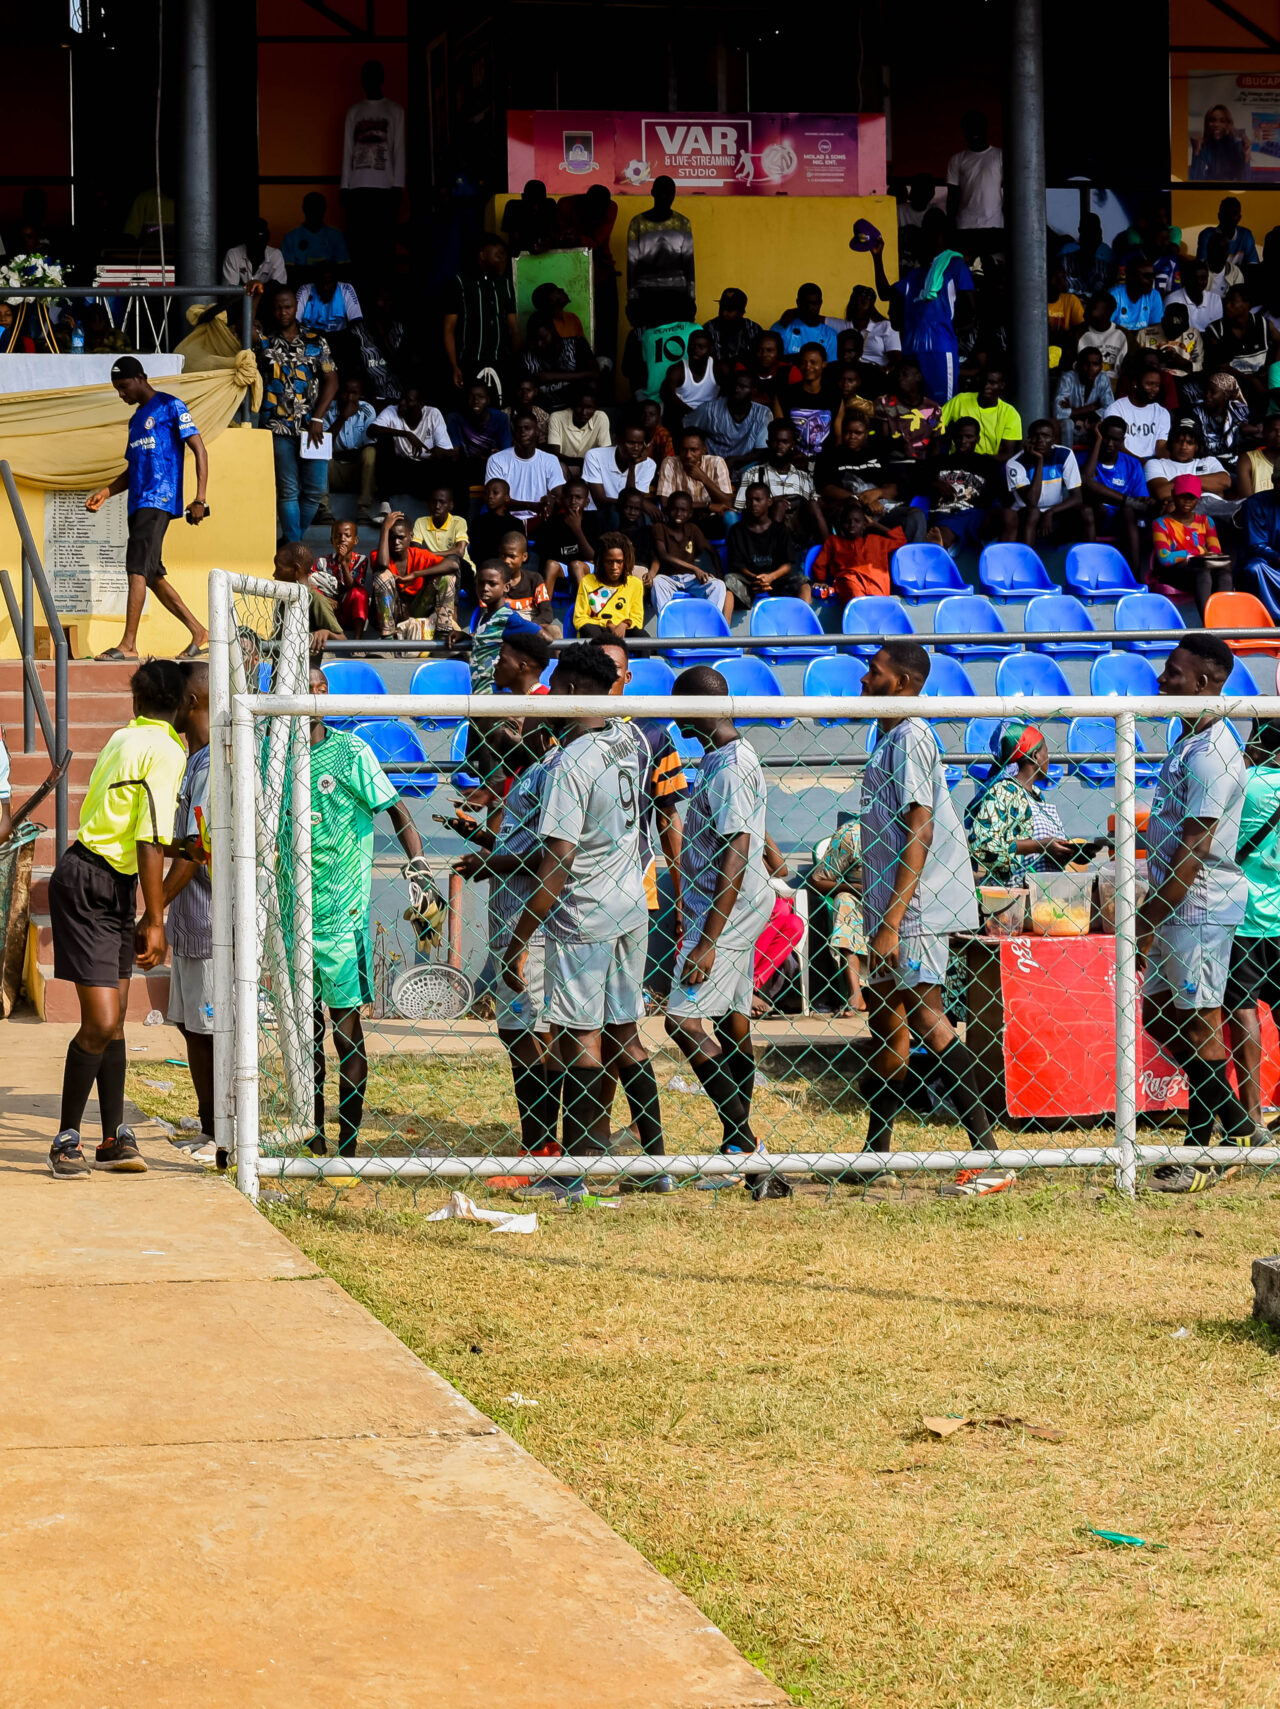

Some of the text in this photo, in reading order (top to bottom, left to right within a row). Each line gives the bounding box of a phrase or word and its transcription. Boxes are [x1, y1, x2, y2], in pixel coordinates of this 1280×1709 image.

[655, 126, 738, 154] VAR
[665, 156, 735, 166] & LIVE-STREAMING
[678, 168, 717, 177] STUDIO
[655, 335, 686, 362] 10
[618, 768, 637, 830] 9
